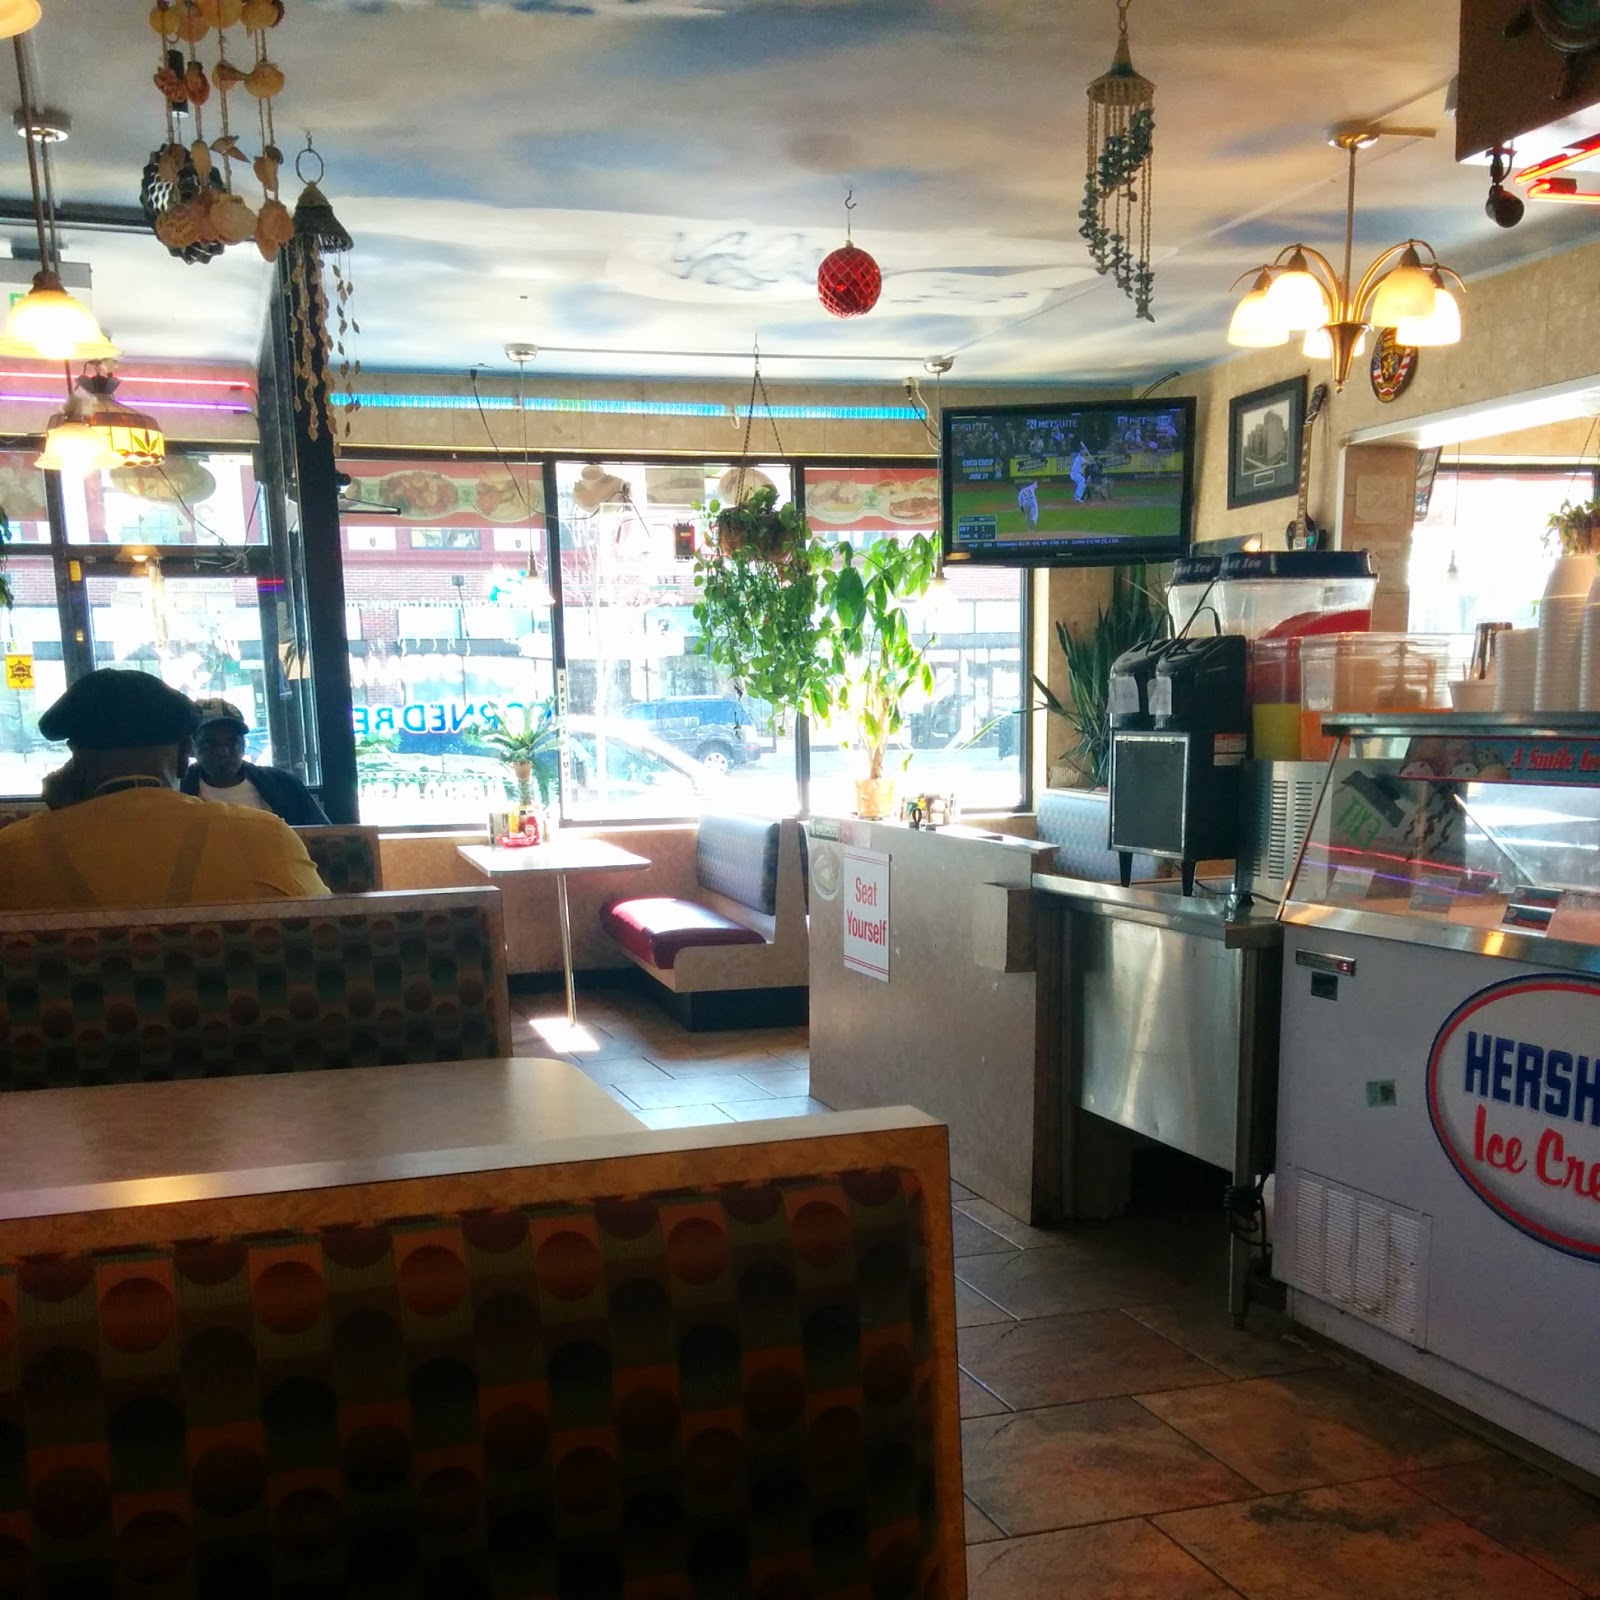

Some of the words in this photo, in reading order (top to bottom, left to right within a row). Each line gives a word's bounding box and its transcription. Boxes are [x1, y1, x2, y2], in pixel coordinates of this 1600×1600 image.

[1505, 746, 1522, 769] A
[1526, 745, 1576, 770] Smile
[855, 876, 878, 907] Seat
[846, 909, 887, 947] Yourself
[1464, 1030, 1600, 1127] HERSH
[1473, 1103, 1528, 1174] Ice
